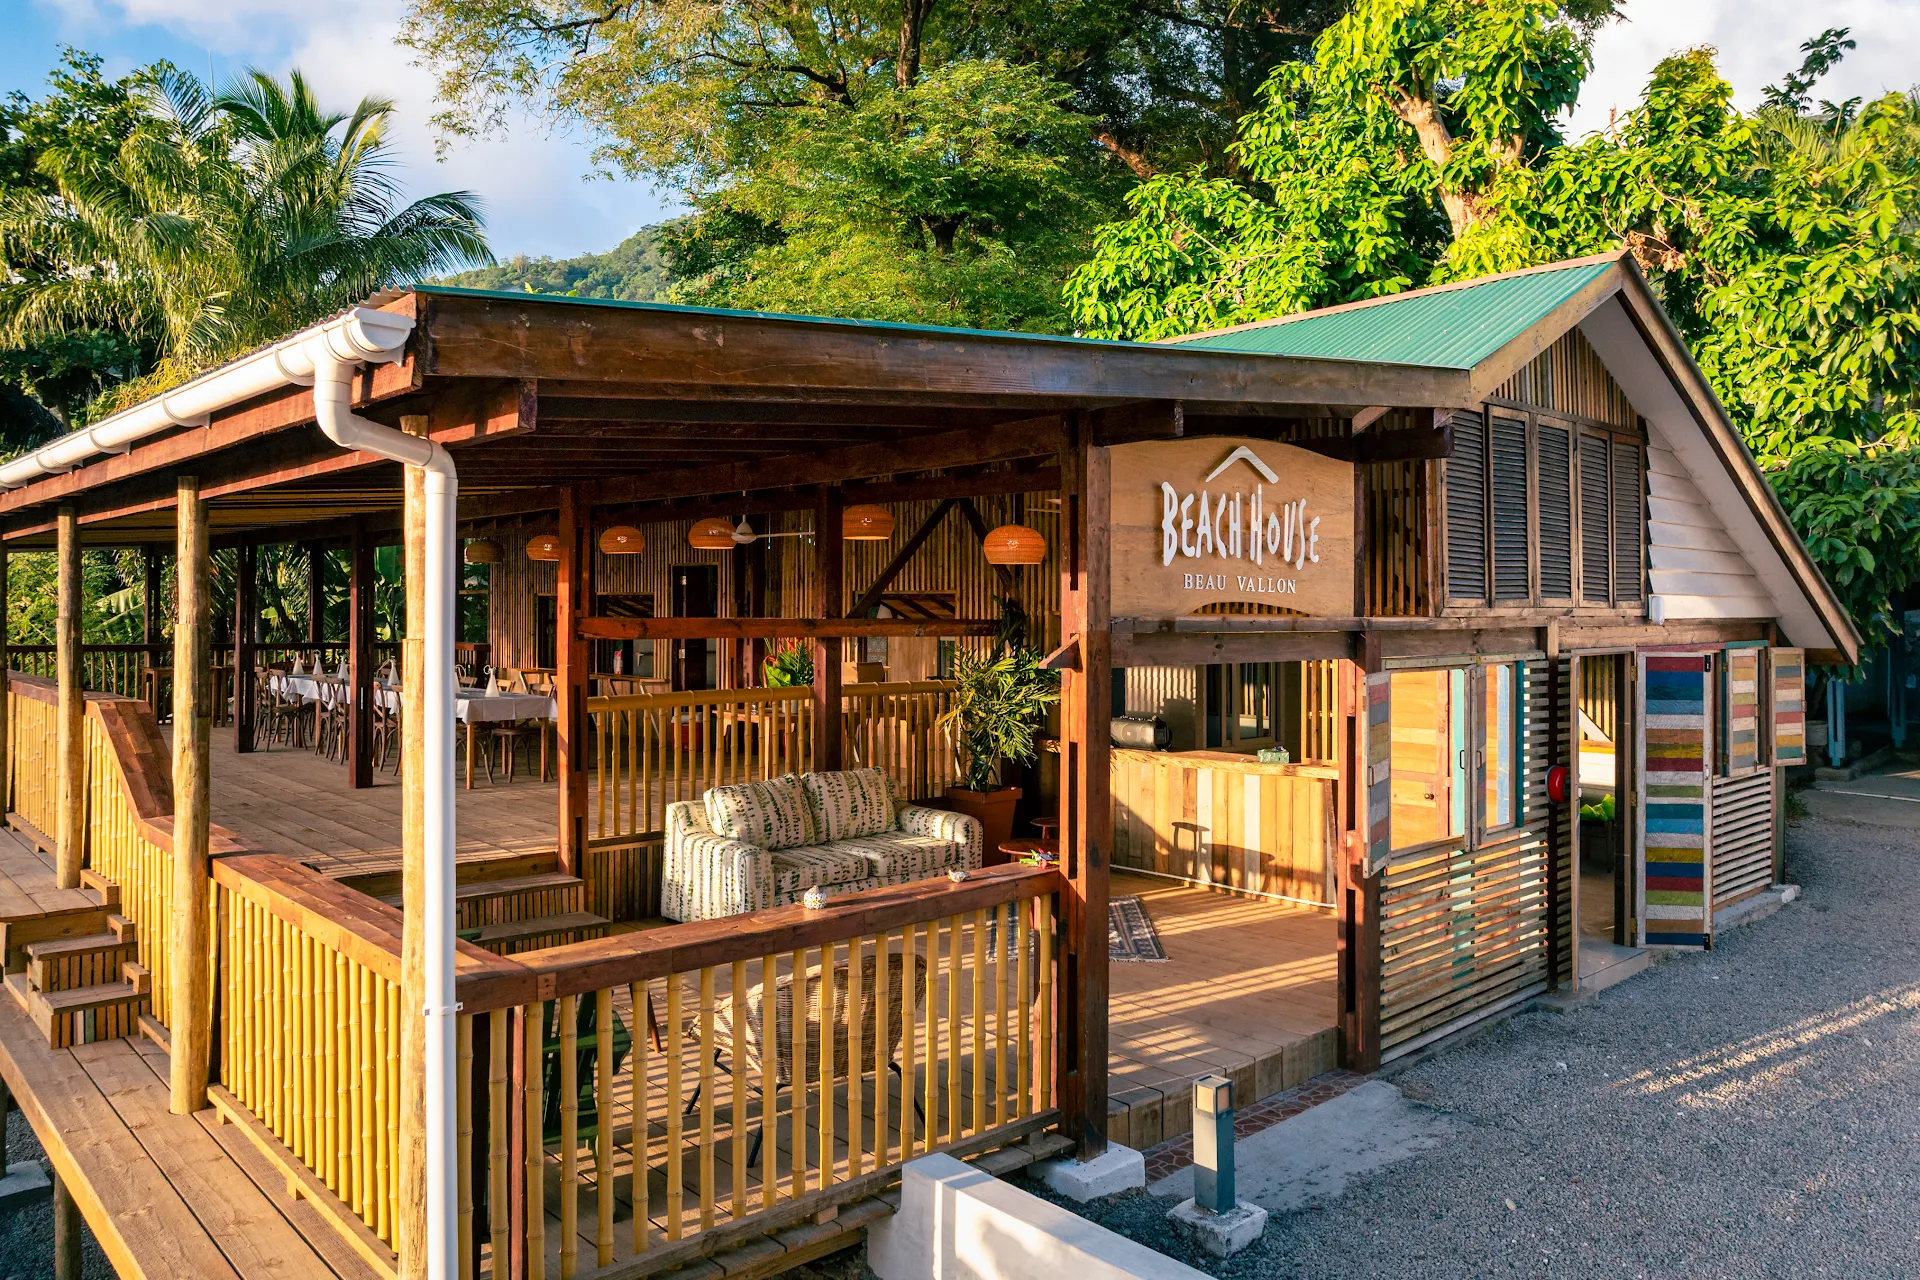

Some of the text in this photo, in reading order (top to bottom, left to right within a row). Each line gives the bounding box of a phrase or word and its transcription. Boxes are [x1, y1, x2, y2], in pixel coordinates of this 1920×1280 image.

[1162, 481, 1320, 571] BEACH HOUSE
[1183, 573, 1297, 594] BEAU VALLON
